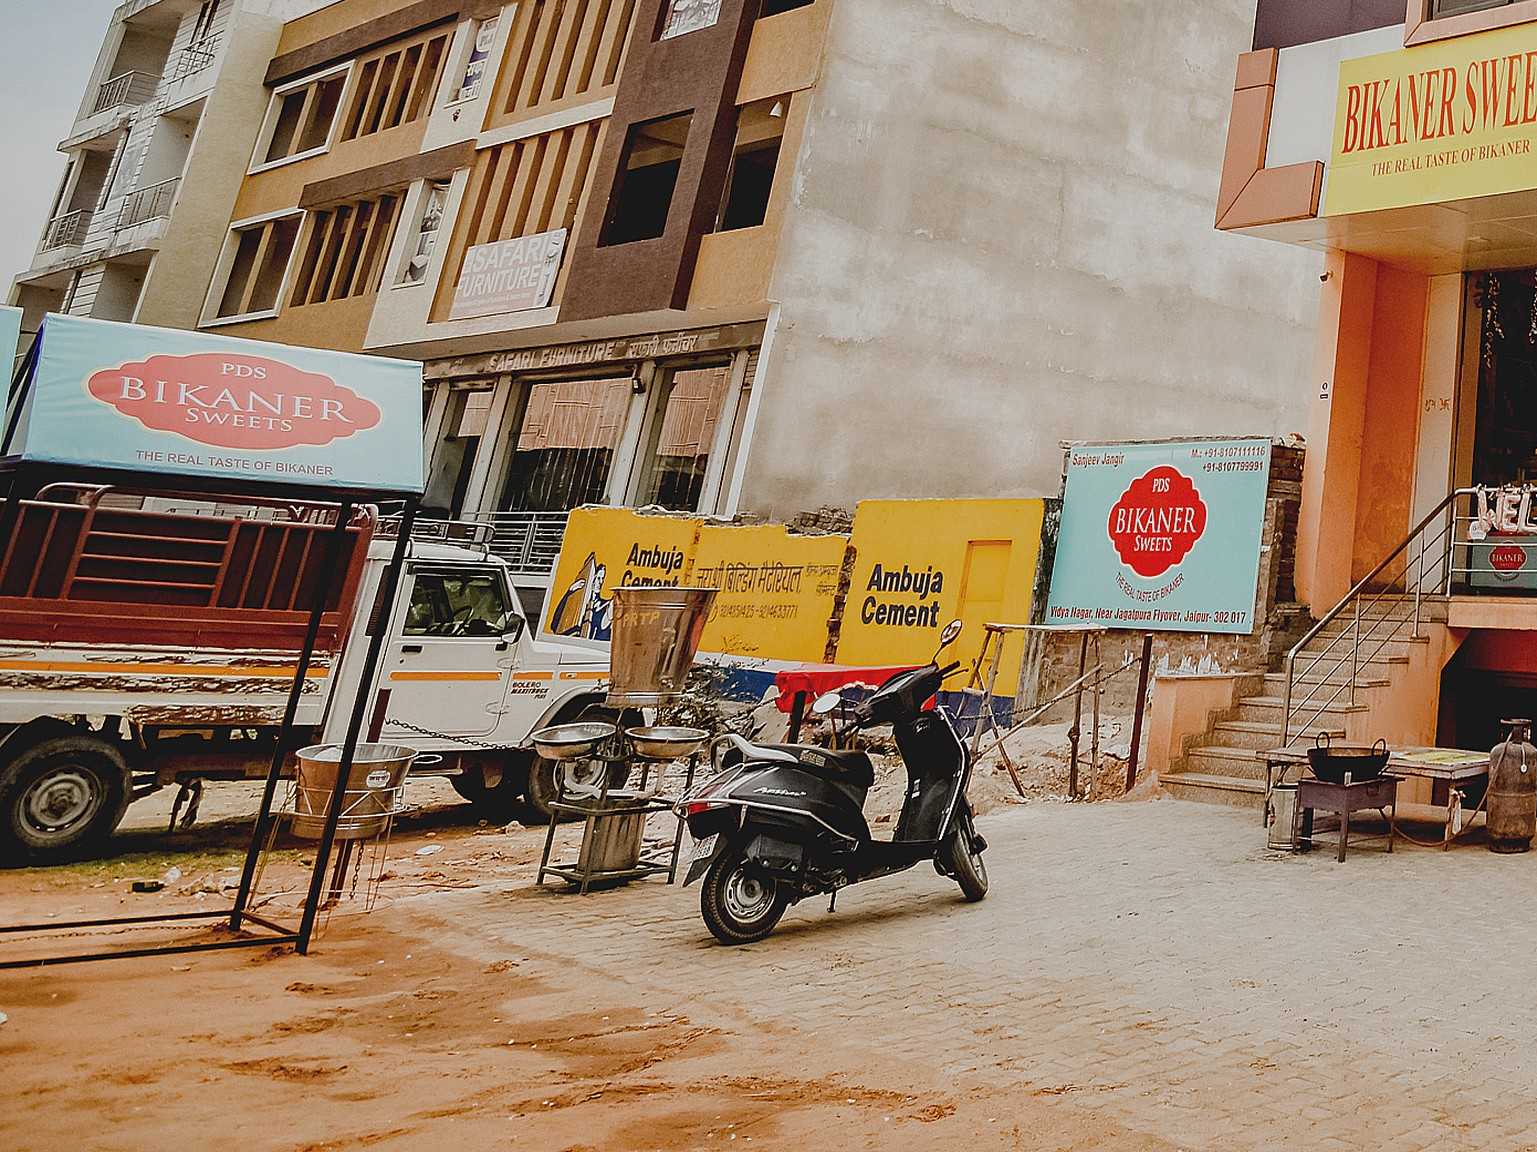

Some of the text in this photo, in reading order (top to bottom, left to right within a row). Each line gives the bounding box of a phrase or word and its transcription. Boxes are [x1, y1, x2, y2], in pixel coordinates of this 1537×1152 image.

[1341, 68, 1457, 155] BIKANER
[1372, 139, 1530, 177] THE REAL TASTE OF BIKANER
[220, 362, 267, 380] PDS
[490, 342, 616, 372] SAFARI FURNITURE
[119, 375, 354, 425] BIKANER
[185, 407, 293, 432] SWEETS
[136, 449, 333, 476] THE REAL TASTE OF BIKANER
[1072, 451, 1125, 469] Sanjeev Jangir
[1152, 478, 1170, 493] PDS
[1115, 506, 1197, 534] BIKANER
[1133, 535, 1173, 552] SWEETS
[626, 543, 684, 575] Ambuja
[866, 564, 944, 600] Ambuja
[1136, 589, 1152, 602] TASTE
[1161, 573, 1185, 599] BIKANER
[861, 596, 940, 627] Cement
[1050, 606, 1070, 619] Vidya
[1095, 608, 1113, 619] Near
[1114, 608, 1151, 622] Jagatpura
[1214, 611, 1229, 624] 302
[1230, 612, 1246, 624] 017
